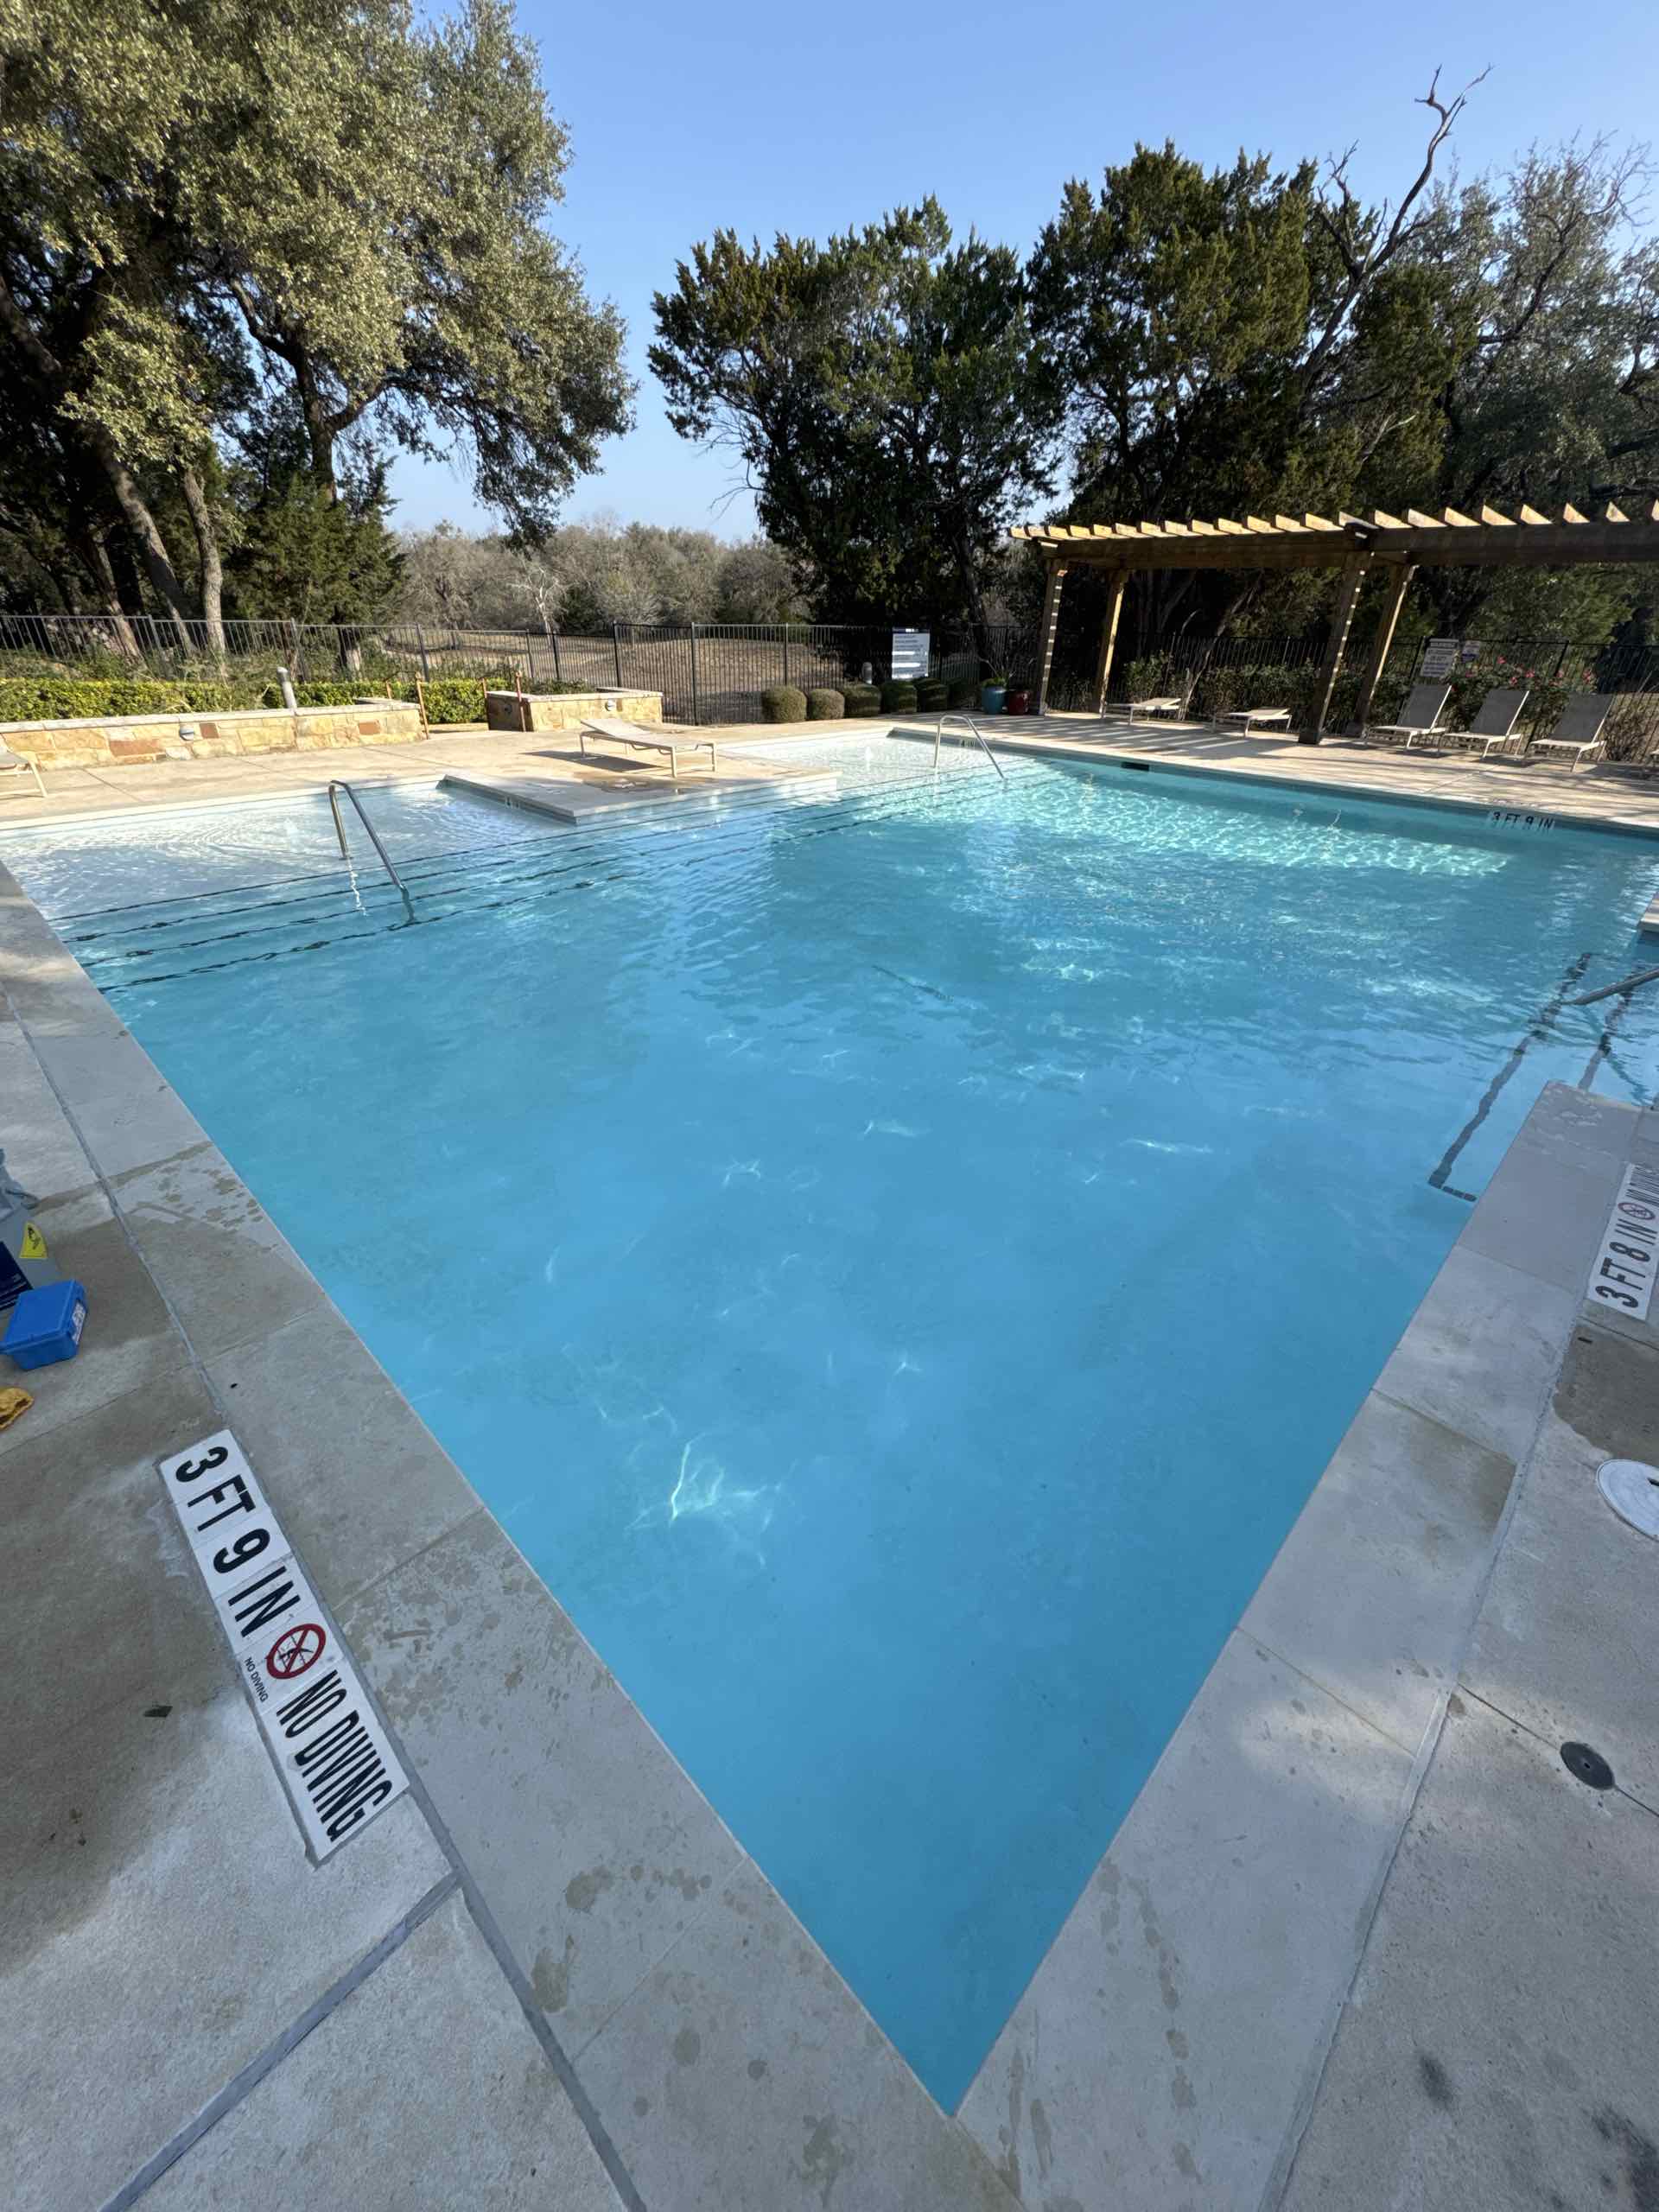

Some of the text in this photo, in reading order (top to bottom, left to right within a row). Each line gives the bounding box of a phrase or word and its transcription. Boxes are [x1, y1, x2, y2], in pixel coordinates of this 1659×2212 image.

[1492, 811, 1554, 829] 3 FT 9 IN
[1614, 1217, 1658, 1245] IN
[1609, 1242, 1651, 1262] 8
[1599, 1256, 1646, 1291] FT
[1595, 1285, 1639, 1308] 3
[175, 1446, 392, 1842] 3 FT 9 IN NO DIVING
[244, 1656, 269, 1702] NO DIVING
